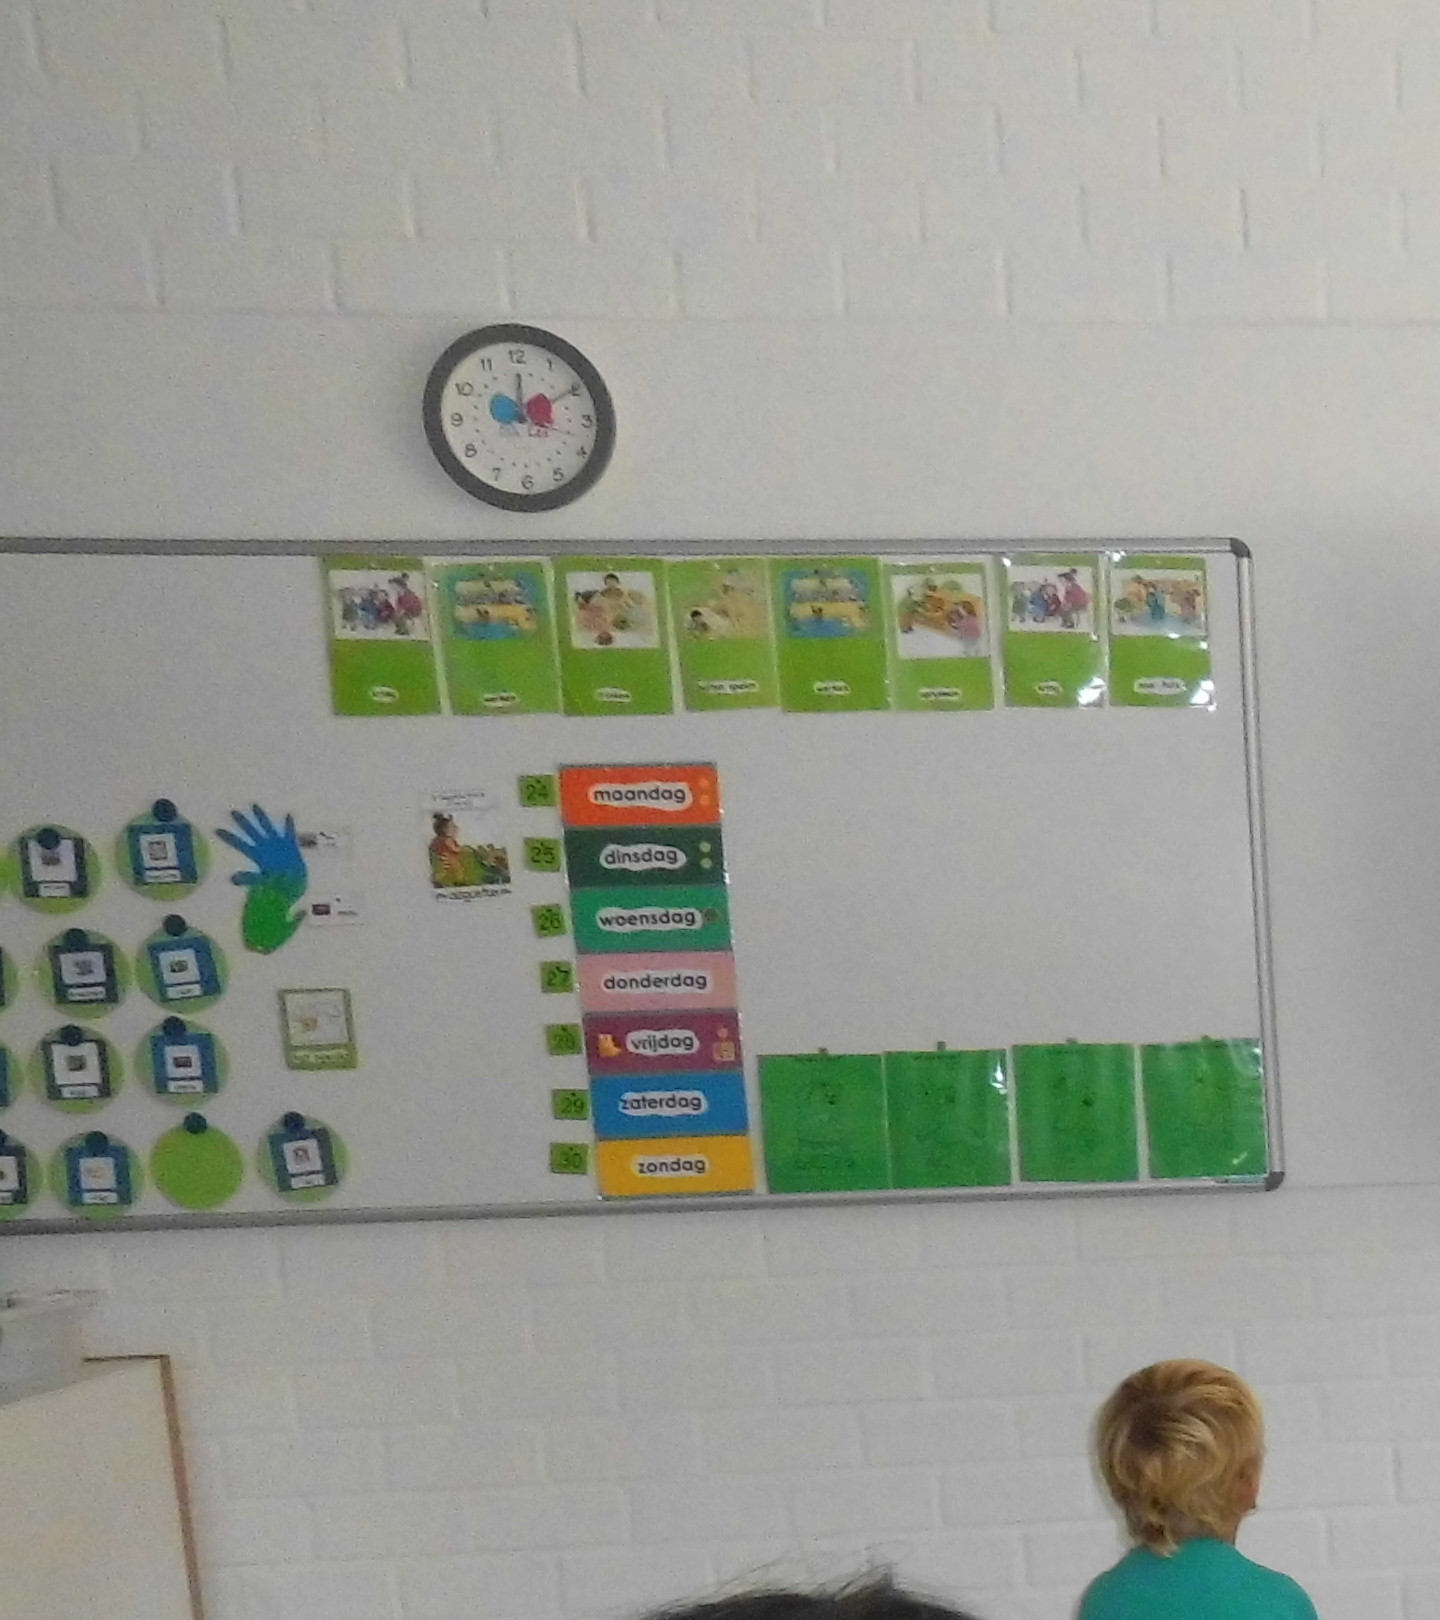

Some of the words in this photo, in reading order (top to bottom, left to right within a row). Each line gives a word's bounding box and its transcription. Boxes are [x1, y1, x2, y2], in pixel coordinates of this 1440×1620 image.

[481, 358, 493, 371] 11
[508, 349, 526, 365] 12
[547, 358, 553, 371] 1
[455, 382, 474, 397] 10
[451, 412, 464, 427] 9
[581, 414, 594, 429] 3
[464, 443, 478, 458] 8
[493, 467, 502, 481] 7
[553, 467, 565, 482] 5
[521, 475, 535, 490] 6
[526, 783, 548, 801] 24
[593, 786, 686, 803] maandag
[531, 846, 555, 864] 25
[604, 849, 679, 865] dinsdag
[600, 910, 696, 926] woensdag
[603, 974, 707, 990] donderdag
[631, 1035, 695, 1053] vrijdag
[562, 1096, 585, 1114] 29
[621, 1094, 702, 1111] zaterdag
[637, 1157, 706, 1174] zondag
